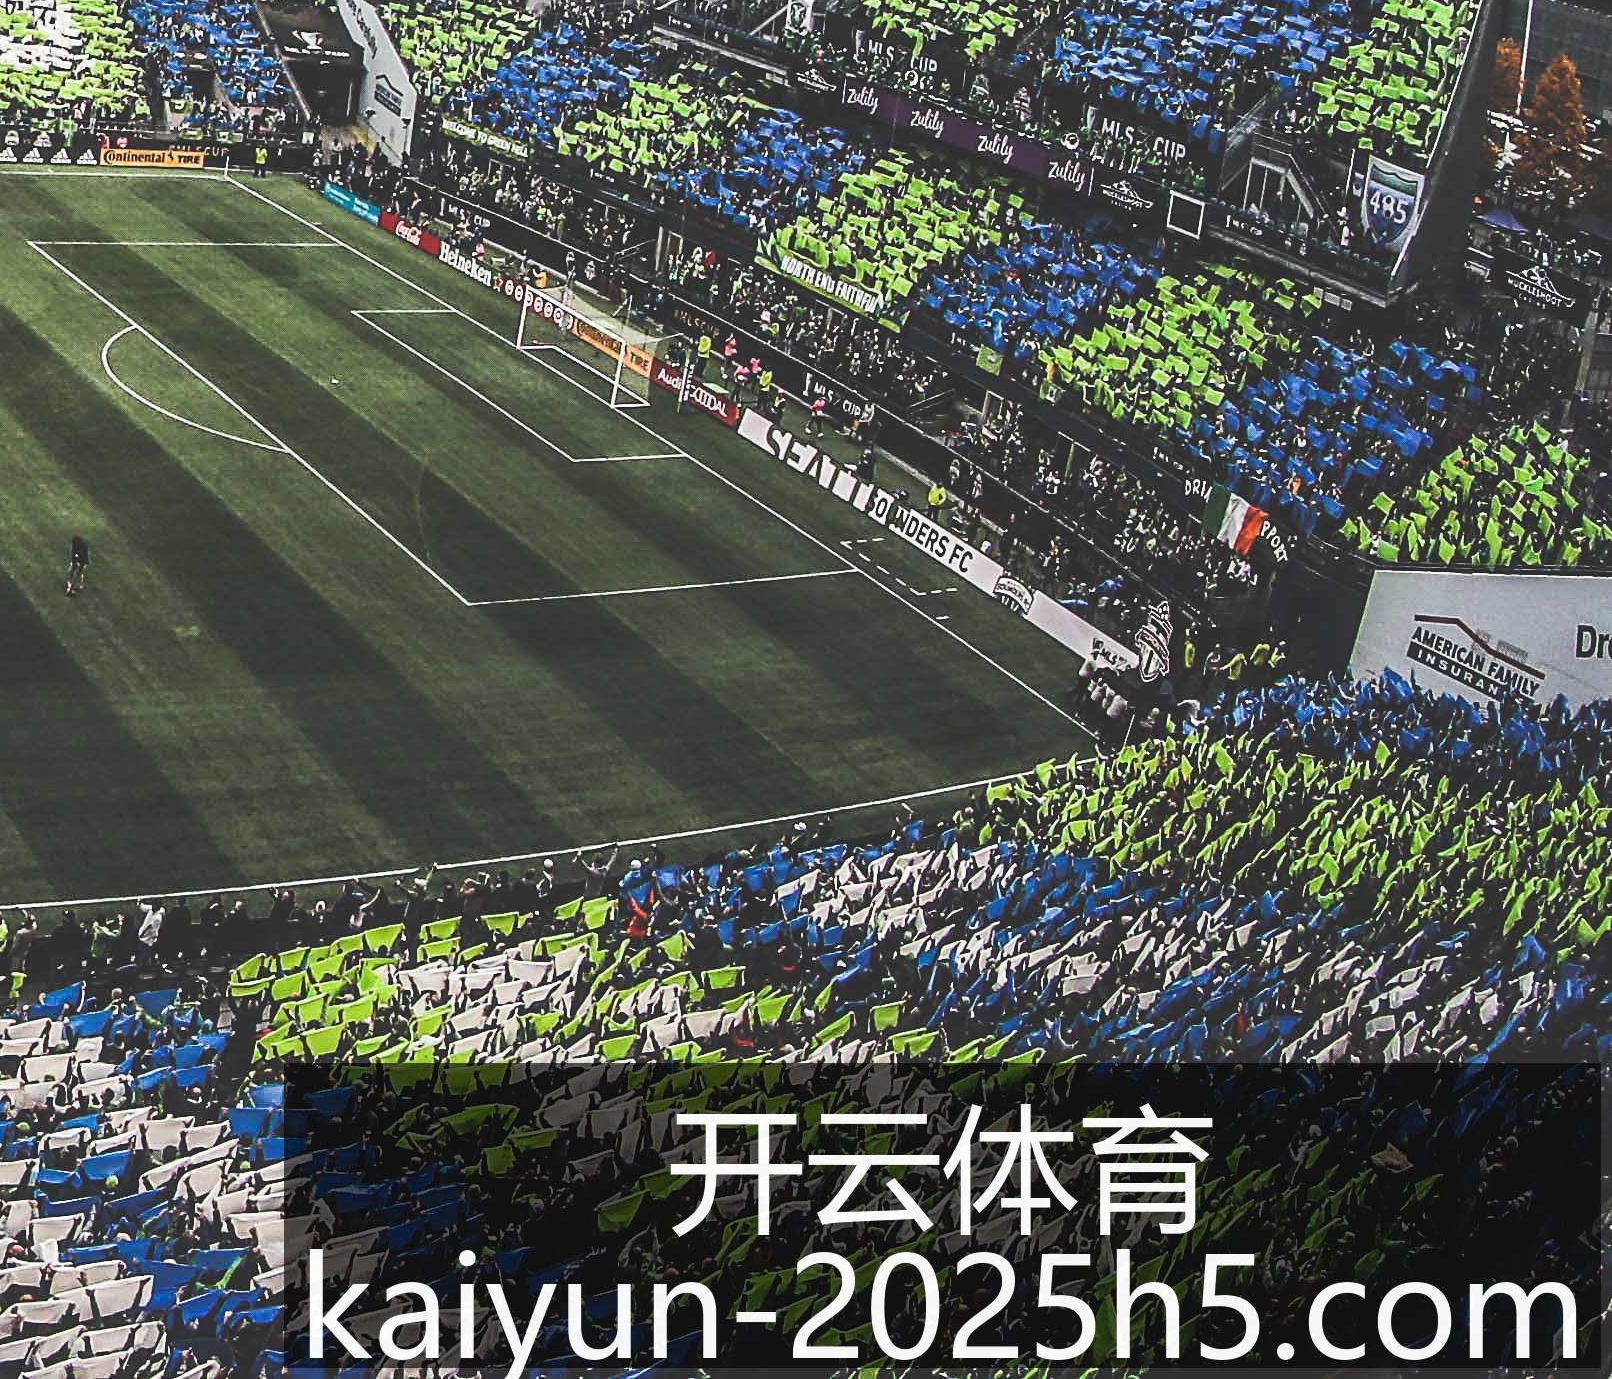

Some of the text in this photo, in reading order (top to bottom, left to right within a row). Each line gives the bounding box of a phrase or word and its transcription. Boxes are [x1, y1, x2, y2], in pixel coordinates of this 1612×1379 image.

[1102, 118, 1133, 145] MLS
[177, 154, 201, 165] TIRE
[1369, 191, 1408, 224] 485
[439, 240, 492, 288] Heineken
[780, 255, 817, 285] NORTH
[657, 367, 682, 394] Audi
[948, 544, 973, 573] FC
[1576, 624, 1612, 659] Dr
[1412, 626, 1540, 696] AMERICAN FAMILY
[1417, 649, 1499, 696] INSURAN
